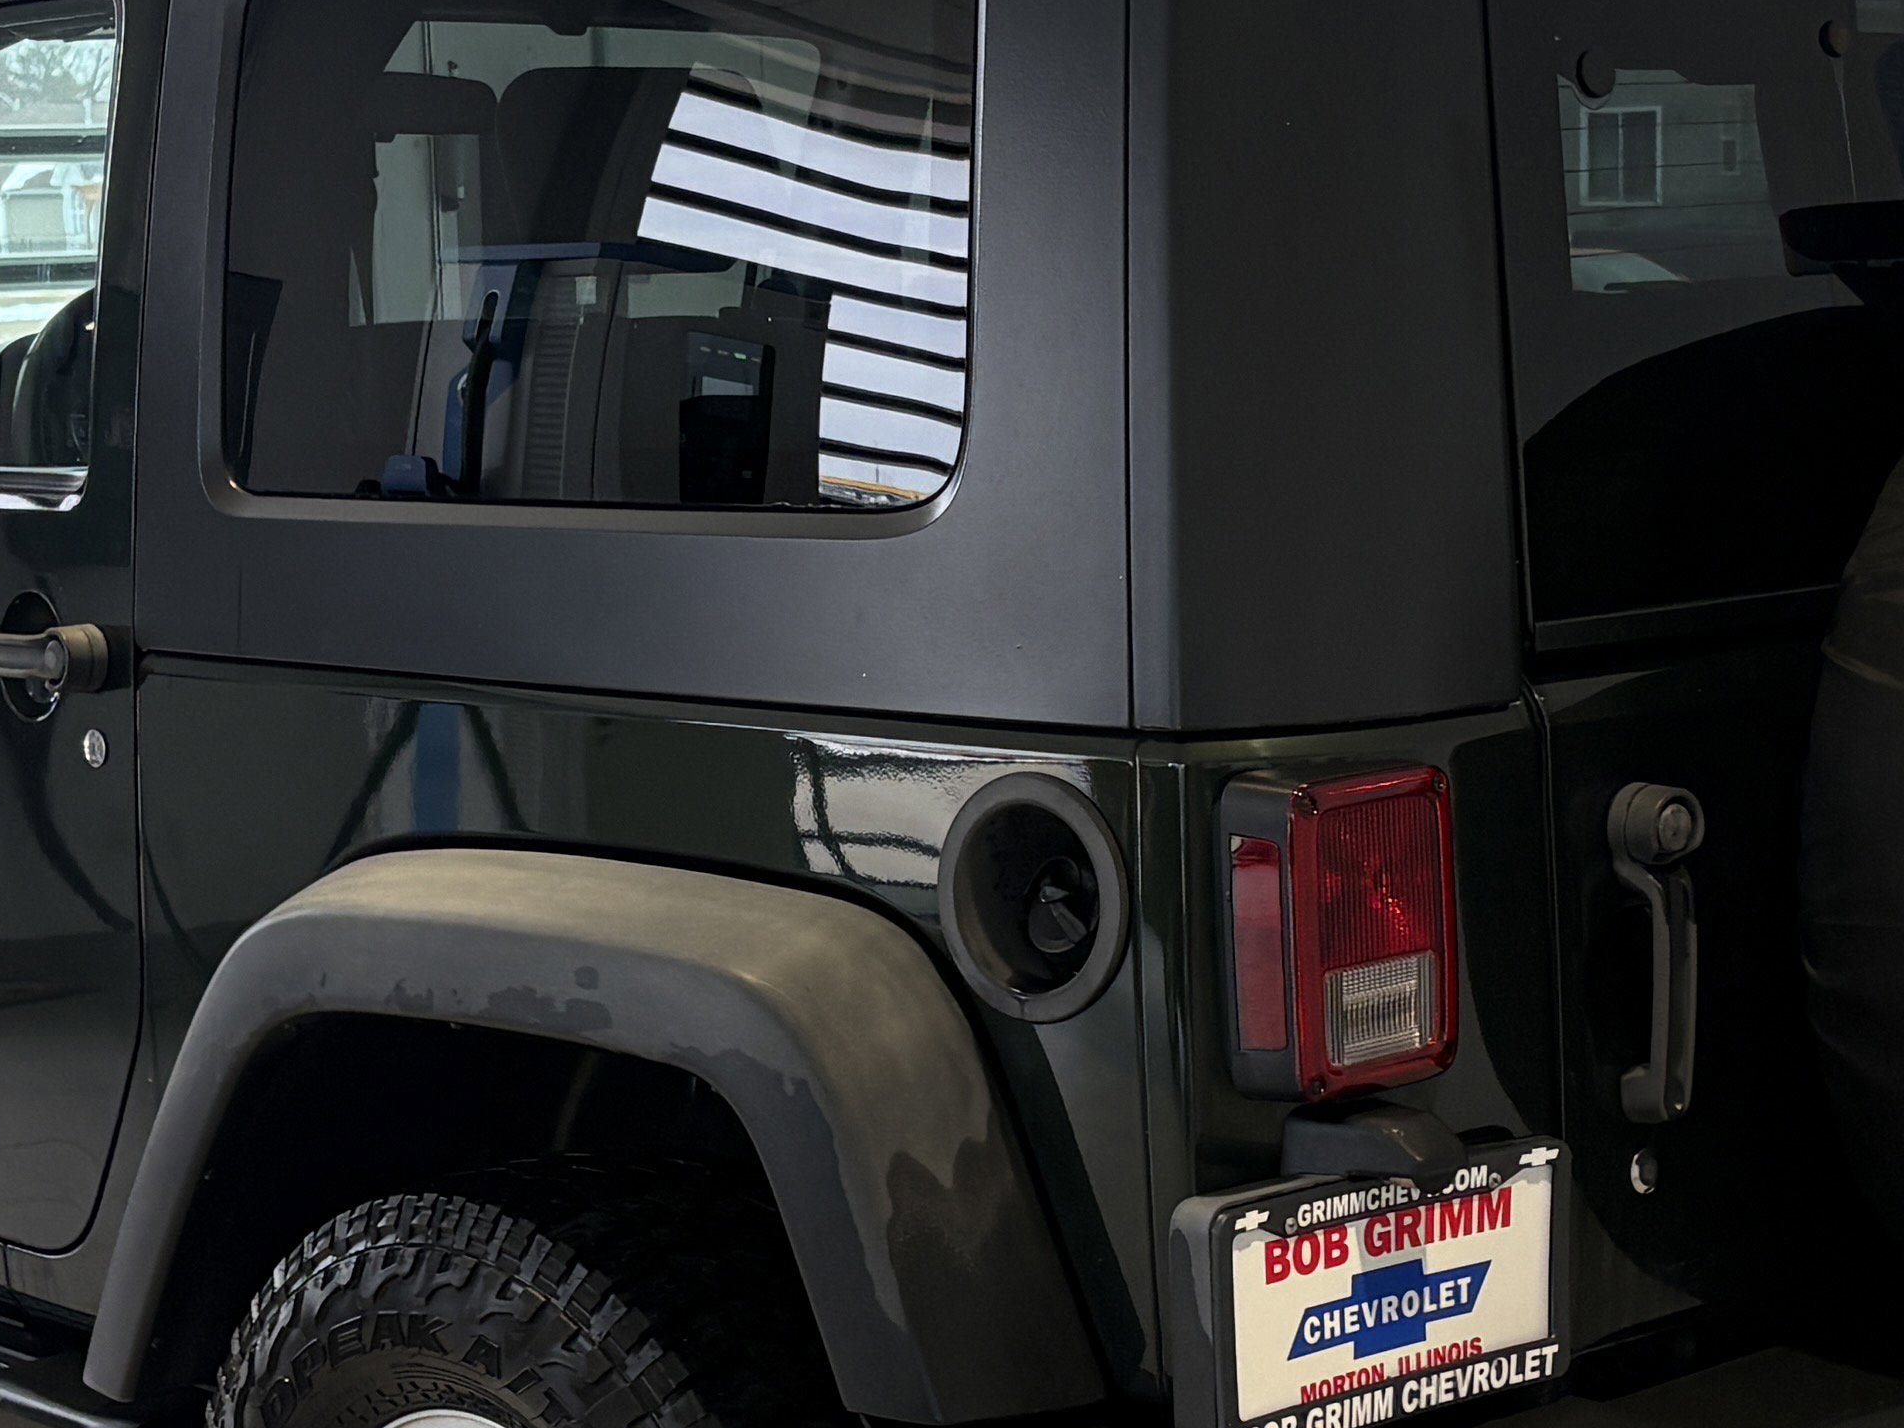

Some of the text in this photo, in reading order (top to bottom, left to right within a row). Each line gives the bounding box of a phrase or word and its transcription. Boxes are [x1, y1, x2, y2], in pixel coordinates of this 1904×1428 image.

[1264, 1186, 1512, 1285] BOB GRIMM
[1303, 1276, 1472, 1345] CHEVROLET
[1397, 1337, 1483, 1377] ILLINOIS
[1401, 1344, 1559, 1413] CHEVROLET
